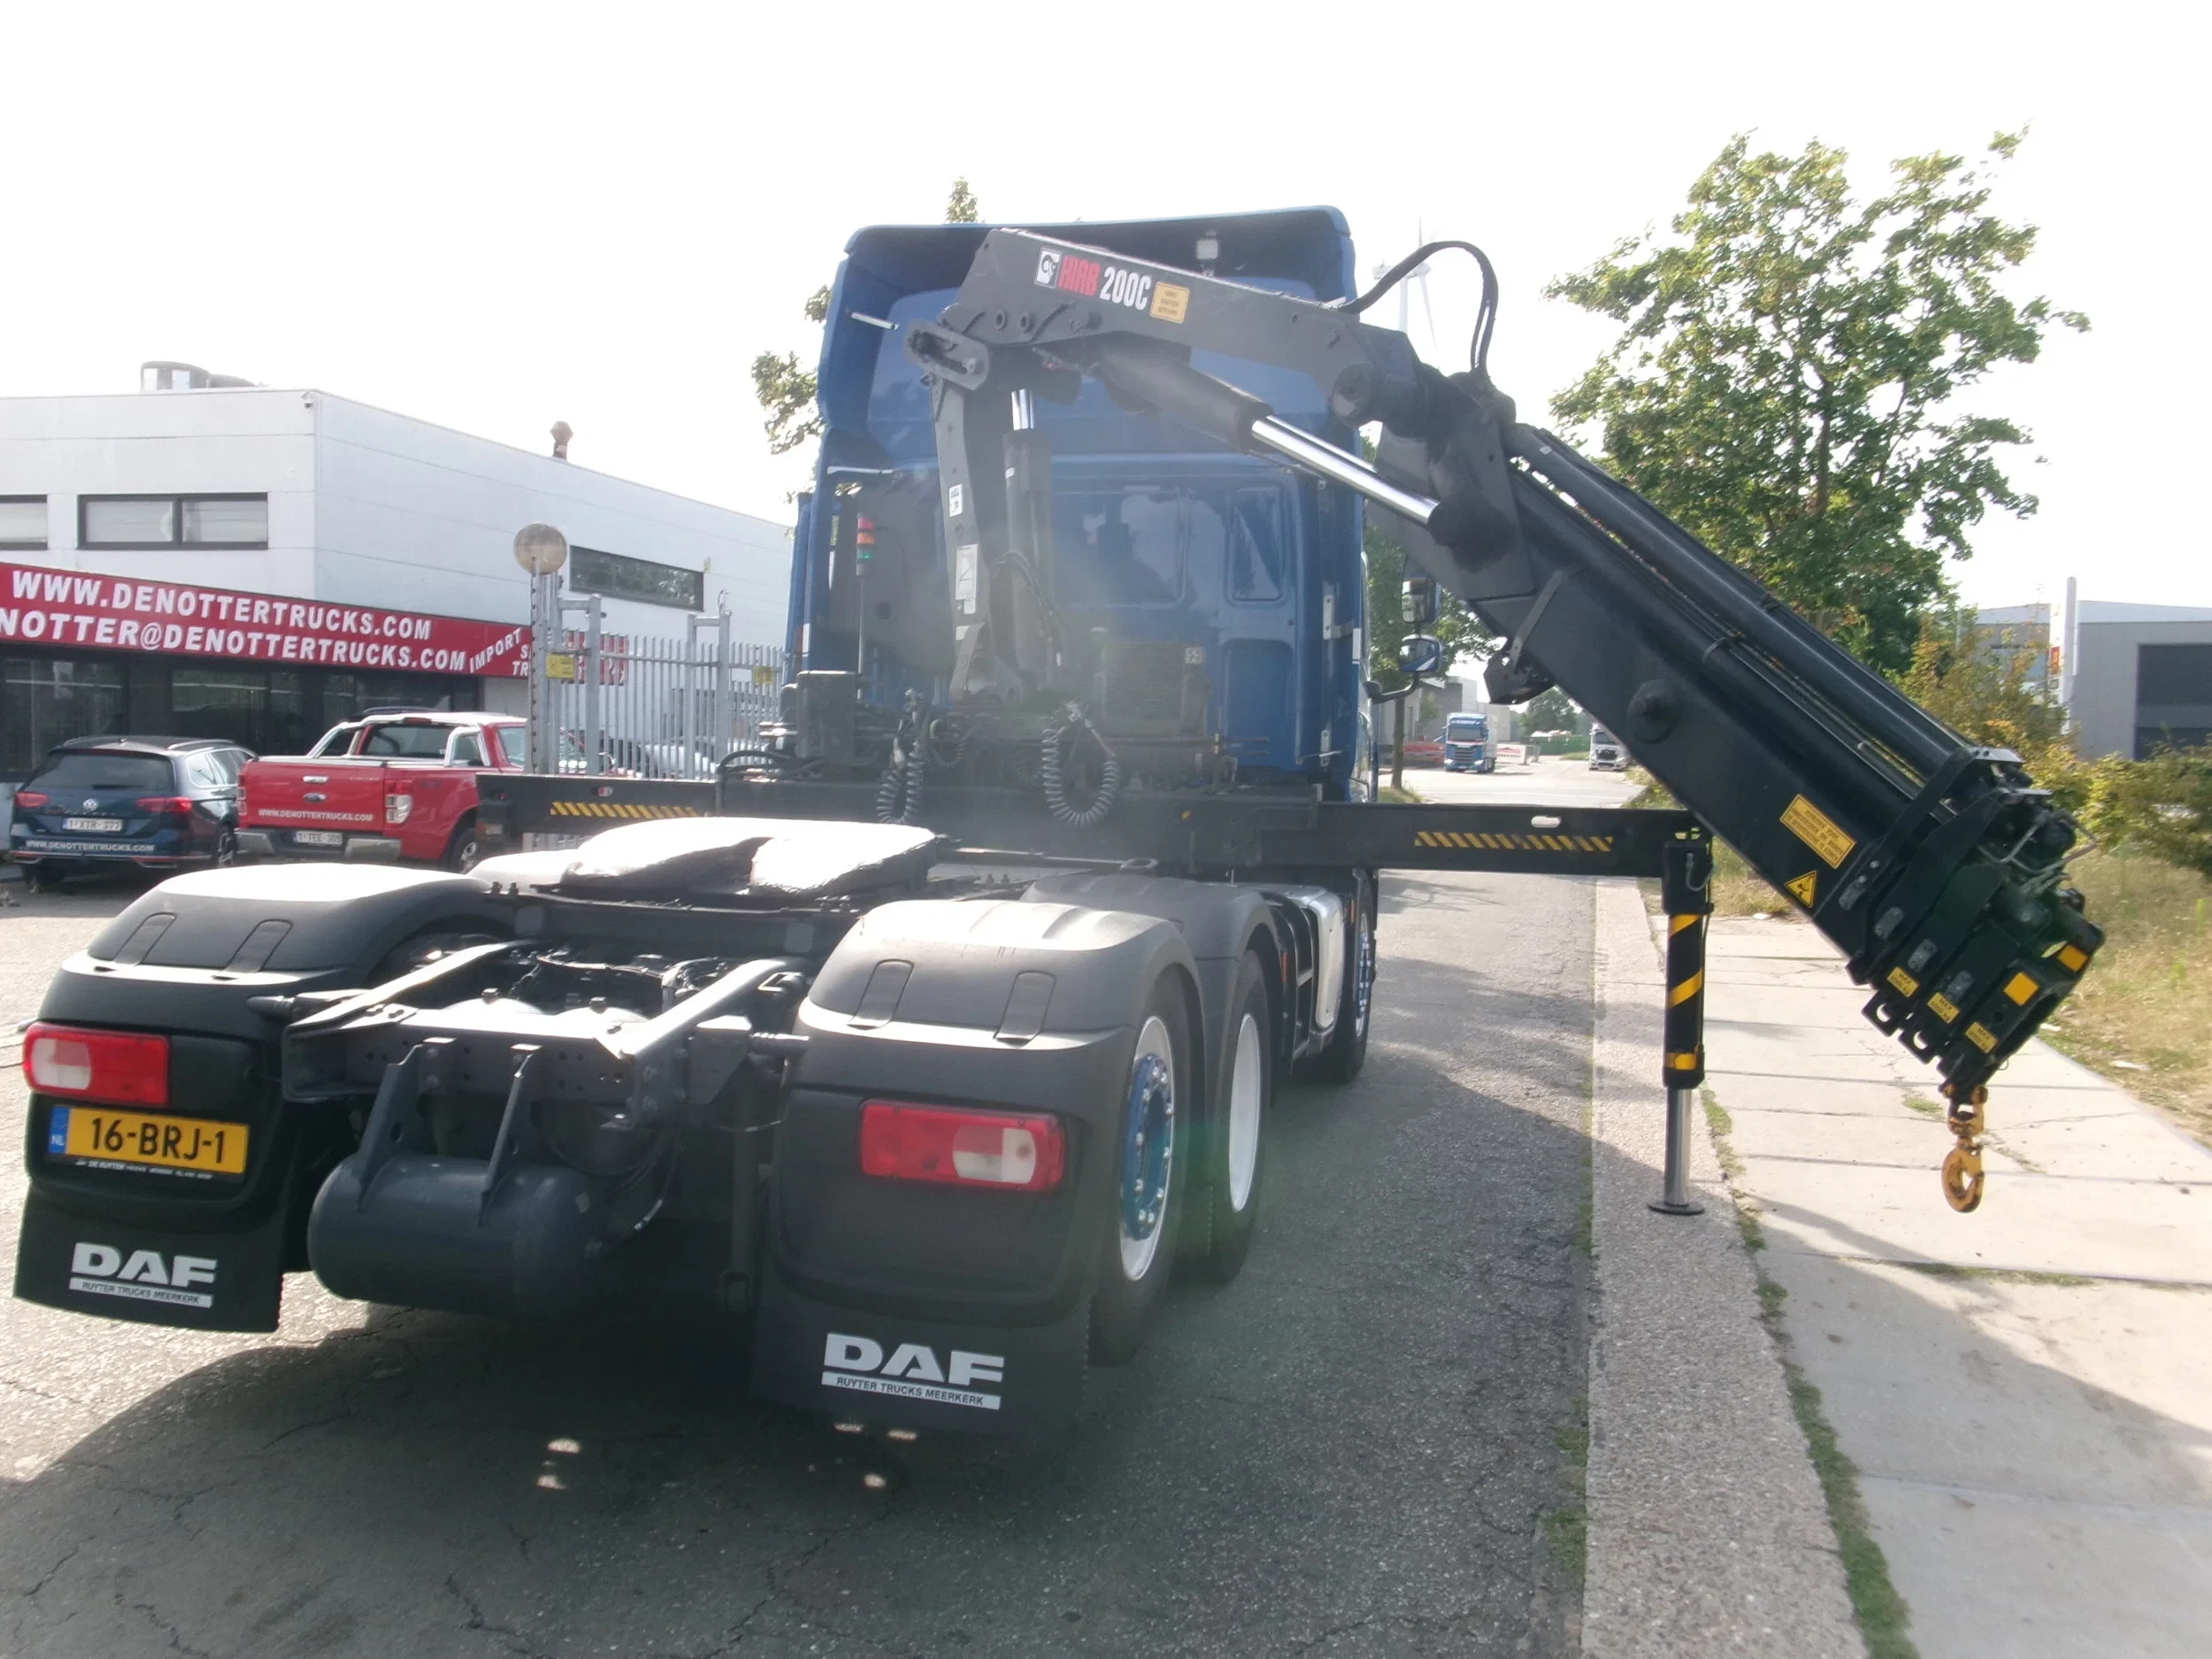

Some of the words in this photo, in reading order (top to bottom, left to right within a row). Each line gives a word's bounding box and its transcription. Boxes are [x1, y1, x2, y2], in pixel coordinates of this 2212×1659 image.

[1100, 266, 1151, 310] 200C
[12, 570, 431, 640] WWW.DENOTTERTRUCKS.COM
[470, 626, 521, 672] IMPORT
[258, 809, 373, 822] WWW.DENOTTERTRUCKS.COM
[50, 1135, 64, 1146] NL
[91, 1118, 226, 1164] 16-BRJ-1
[72, 1242, 218, 1287] DAF
[81, 1281, 115, 1293] RUYTER
[117, 1286, 151, 1298] TRUCKS
[154, 1291, 200, 1304] MEERKERK
[824, 1333, 1005, 1386] DAF
[837, 1376, 877, 1390] RUYTER
[880, 1382, 922, 1397] TRUCKS
[926, 1388, 984, 1406] MEERKERK
